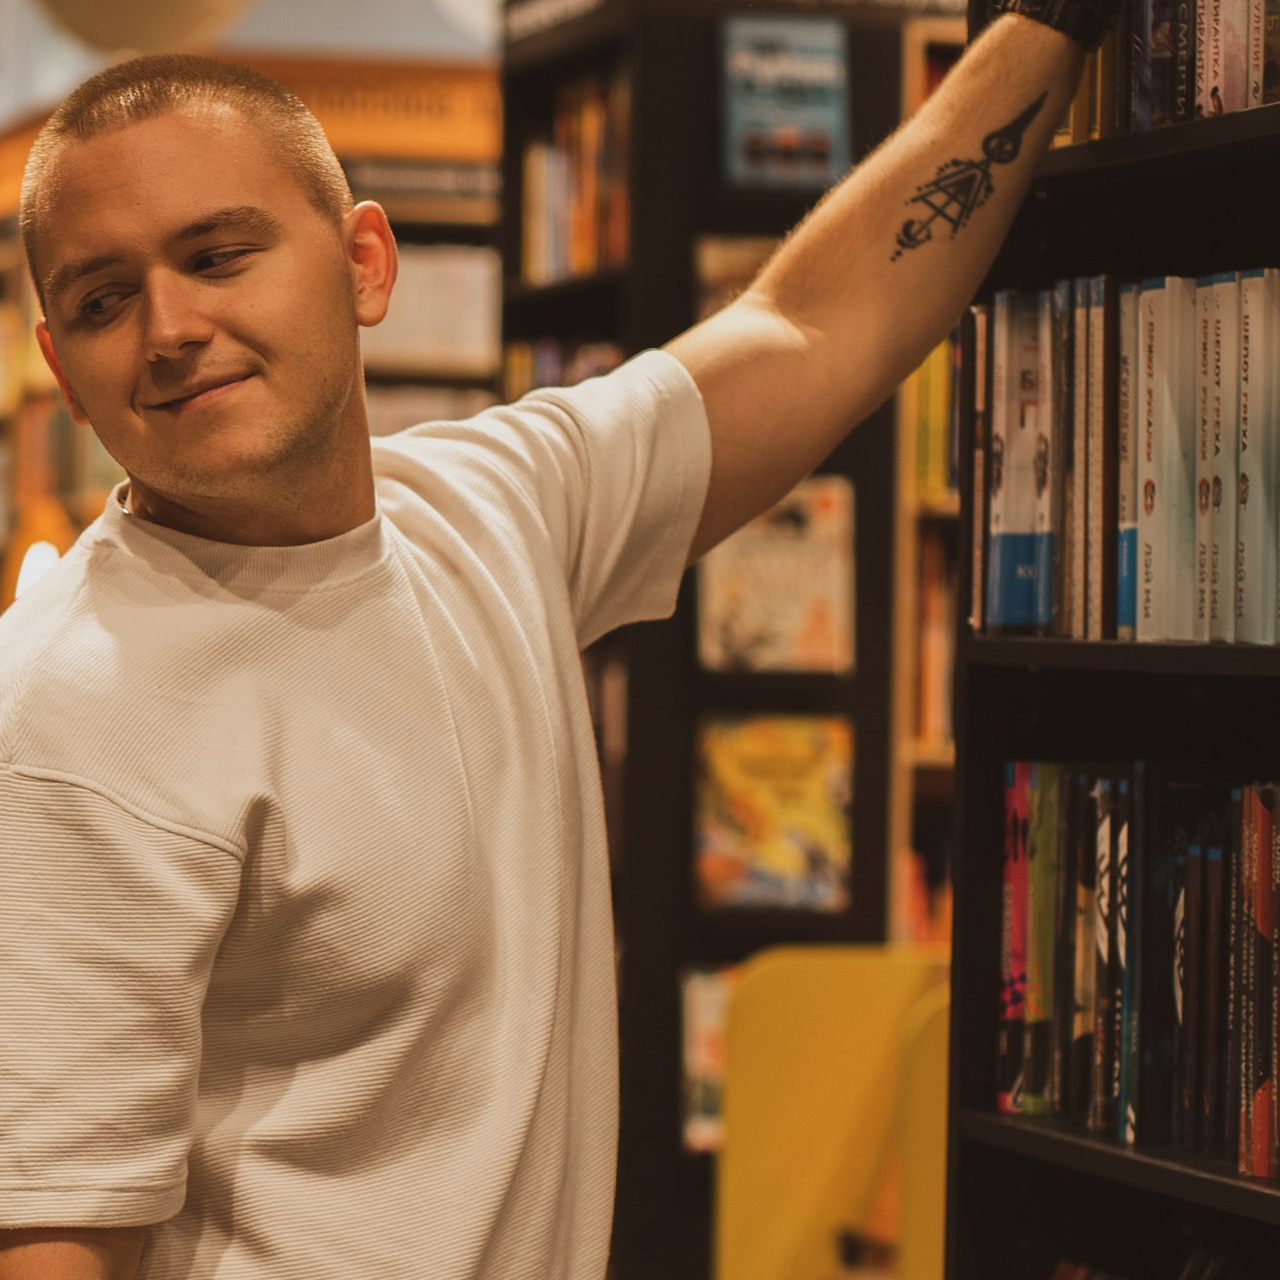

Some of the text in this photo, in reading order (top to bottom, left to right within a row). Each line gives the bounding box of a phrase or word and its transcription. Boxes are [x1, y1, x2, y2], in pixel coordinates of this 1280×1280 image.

[1176, 3, 1190, 115] СМЕРТИ
[1213, 319, 1222, 457] ШЕПОТ ГРЕХА
[1240, 314, 1250, 453] ШЕПОТ ГРЕХА
[1144, 542, 1153, 584] ЛЭЙ
[1199, 541, 1207, 584] ЛЭЙ
[1211, 541, 1220, 584] ЛЭЙ
[1238, 541, 1247, 582] ЛЭЙ
